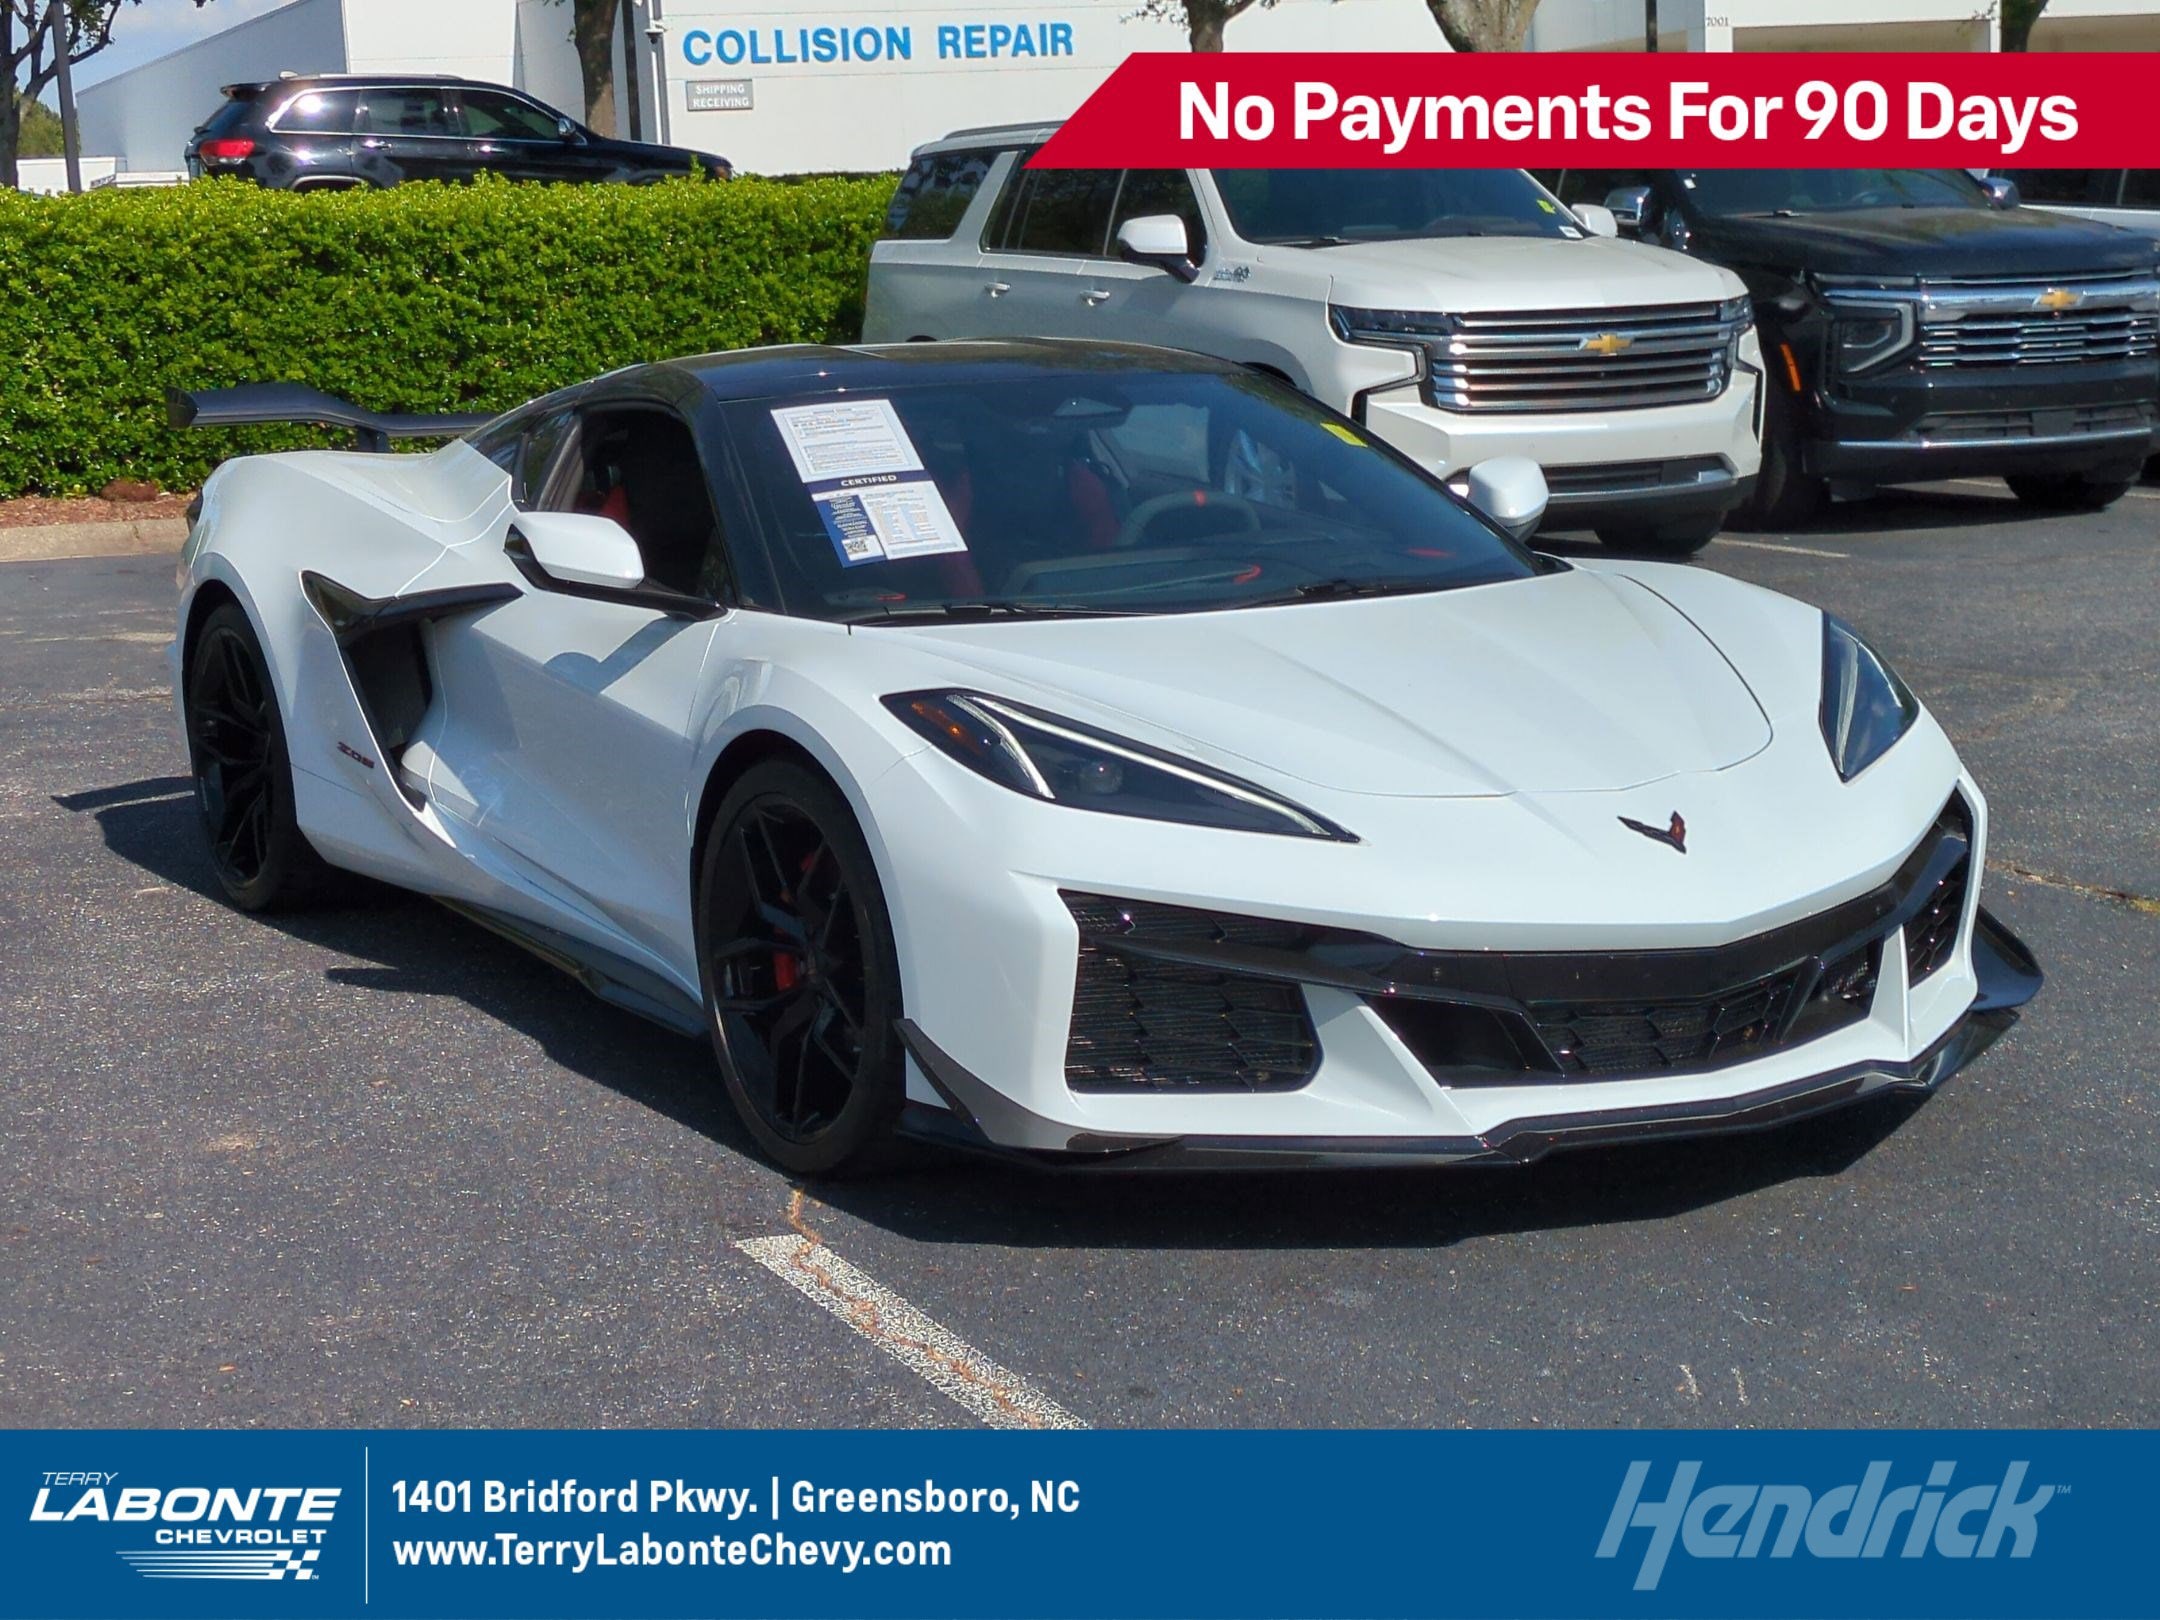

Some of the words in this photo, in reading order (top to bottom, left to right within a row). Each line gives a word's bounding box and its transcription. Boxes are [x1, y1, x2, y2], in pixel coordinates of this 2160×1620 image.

[682, 26, 912, 66] COLLISION
[937, 22, 1074, 59] REPAIR
[695, 84, 745, 95] SHIPPING
[693, 97, 749, 108] RECEIVING
[840, 474, 897, 487] CERTIFIED
[336, 741, 375, 769] Z06
